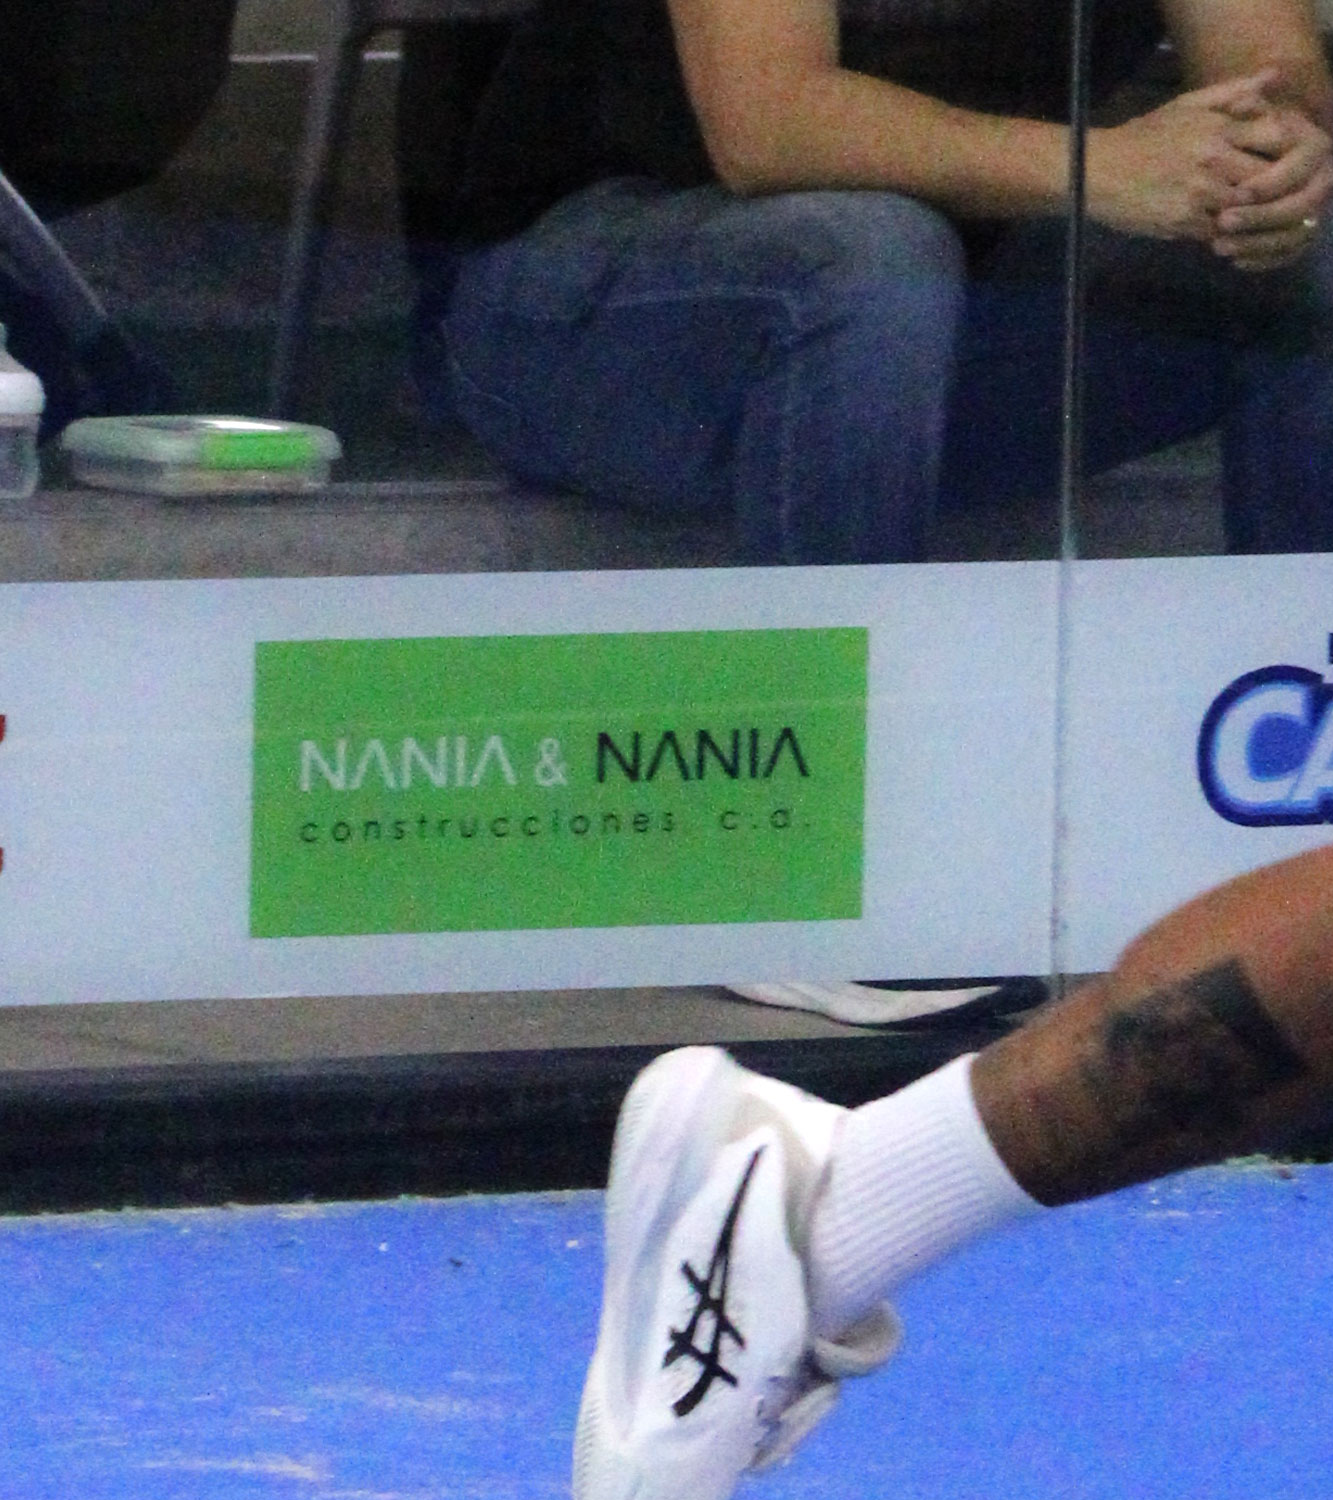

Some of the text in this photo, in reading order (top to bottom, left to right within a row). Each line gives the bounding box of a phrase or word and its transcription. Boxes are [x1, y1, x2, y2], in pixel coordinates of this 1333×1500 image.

[300, 726, 811, 793] NANIA & NANIA
[299, 809, 678, 844] construcciones
